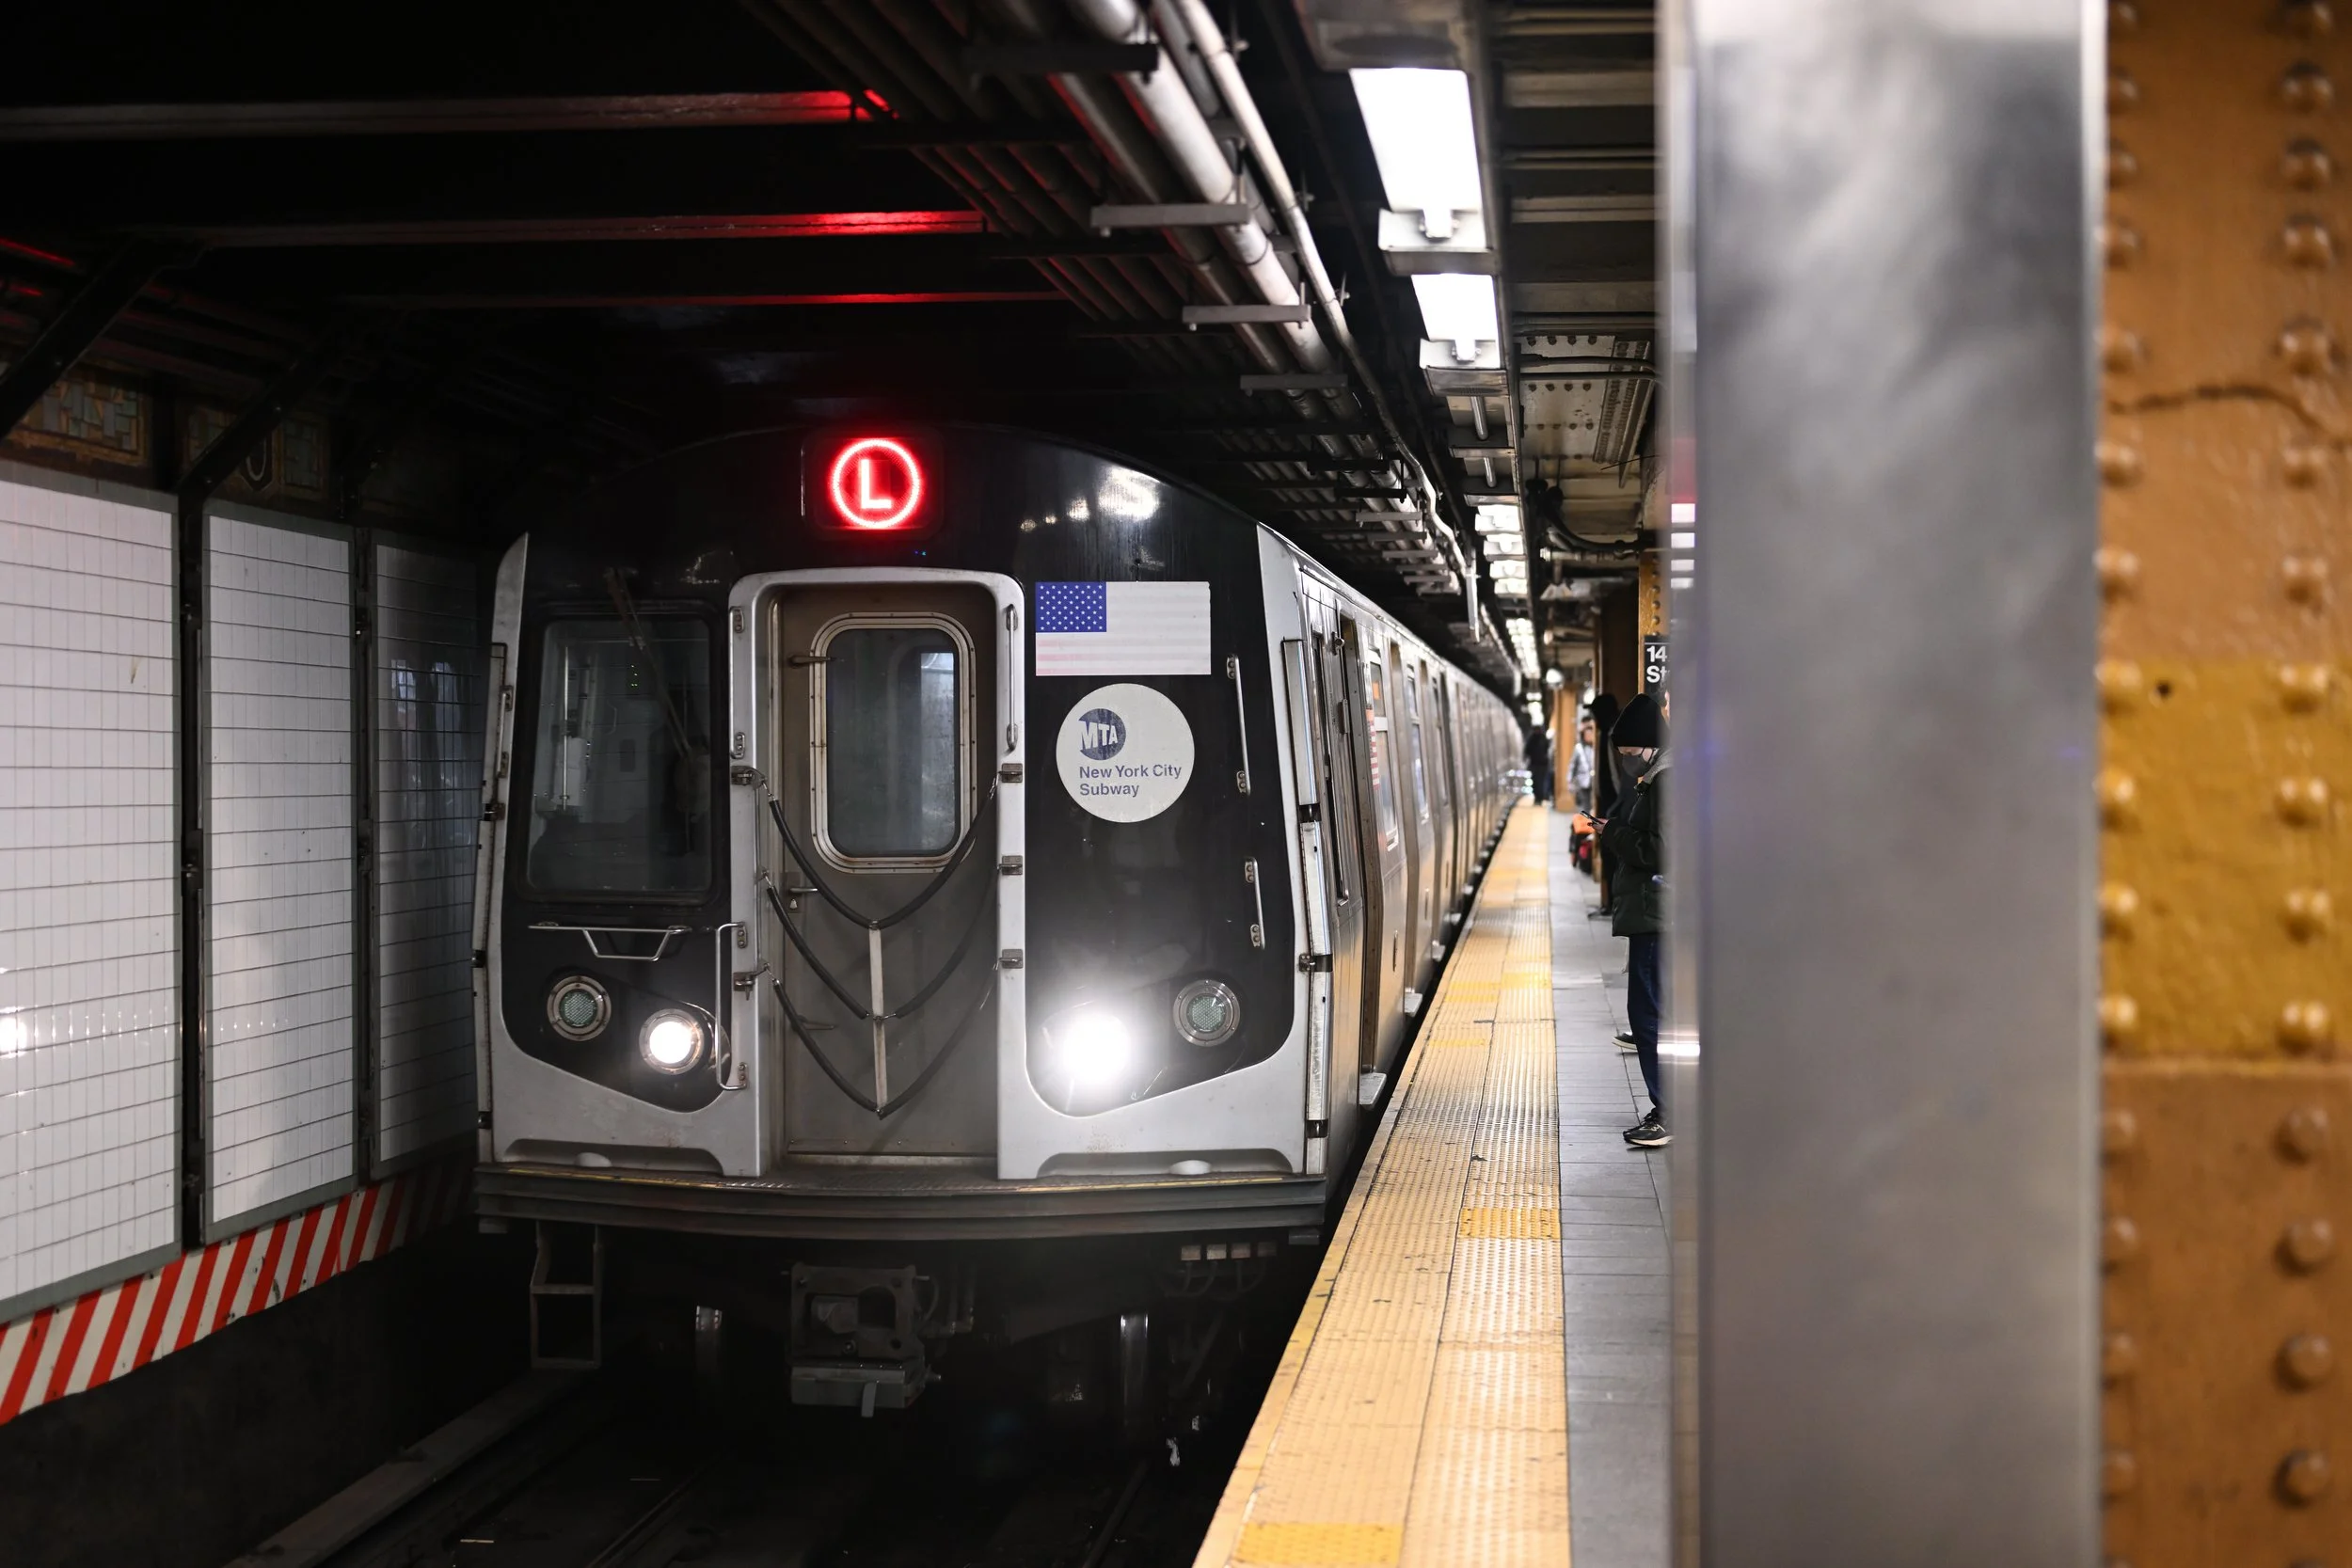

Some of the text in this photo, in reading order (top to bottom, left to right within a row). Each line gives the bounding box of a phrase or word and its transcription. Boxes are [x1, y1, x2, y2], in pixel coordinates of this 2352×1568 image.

[860, 458, 892, 510] L
[1646, 645, 1668, 663] 14
[1079, 721, 1118, 750] MTA
[1079, 764, 1182, 780] New York City
[1079, 783, 1139, 798] Subway
